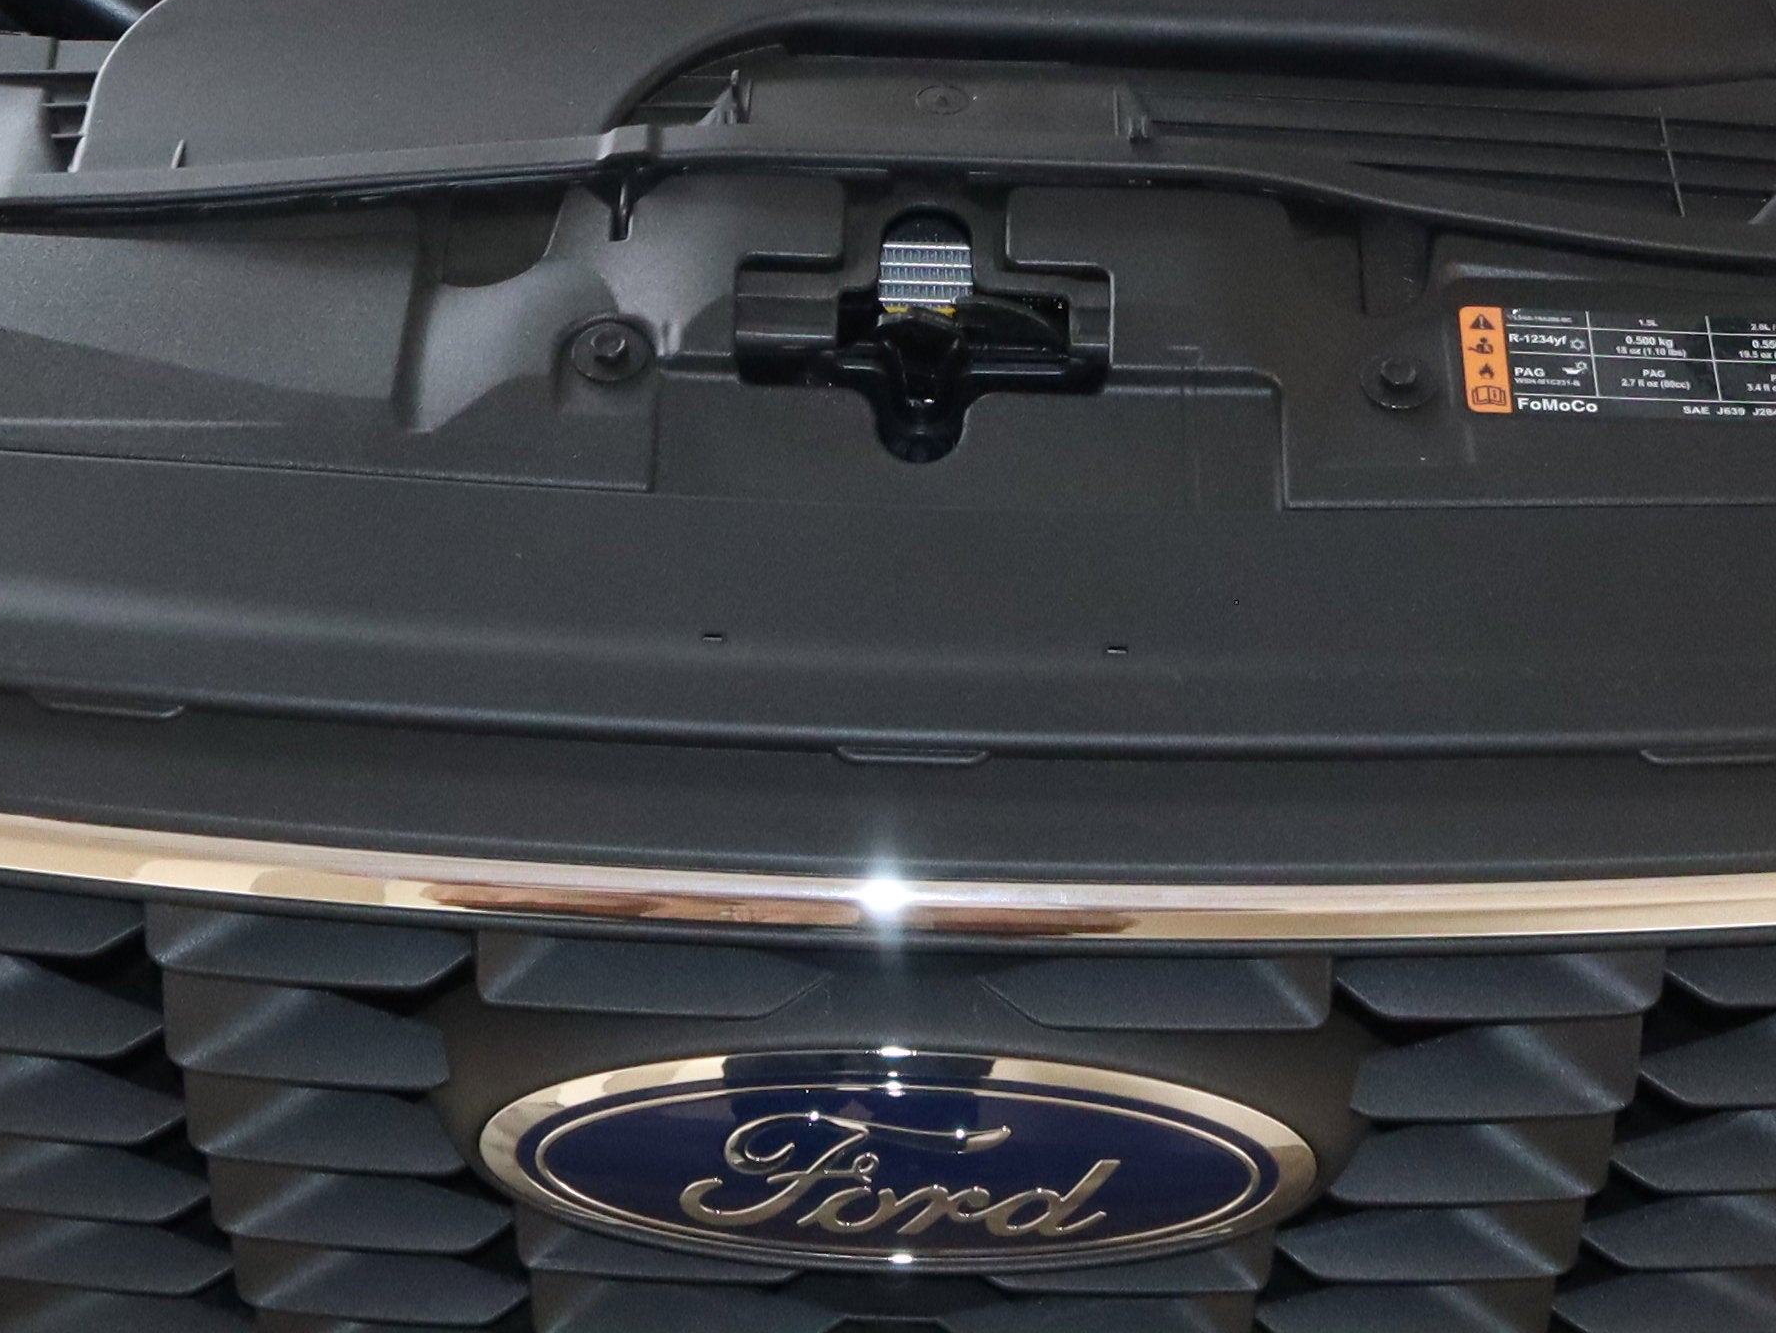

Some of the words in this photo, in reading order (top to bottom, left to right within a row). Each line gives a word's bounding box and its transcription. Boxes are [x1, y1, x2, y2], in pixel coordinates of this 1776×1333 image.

[1508, 333, 1567, 347] R-1234yf
[1625, 335, 1656, 345] 0.500
[1658, 335, 1674, 348] kg
[1760, 351, 1773, 359] oz
[1514, 366, 1546, 377] PAG
[1642, 369, 1666, 378] PAG
[1621, 378, 1636, 387] 2.7
[1646, 380, 1659, 388] oz
[1746, 383, 1762, 392] 3.4
[1517, 397, 1598, 412] FoMoCo
[1682, 405, 1711, 416] SAE
[1716, 406, 1746, 416] J639
[680, 1111, 1122, 1238] Ford
